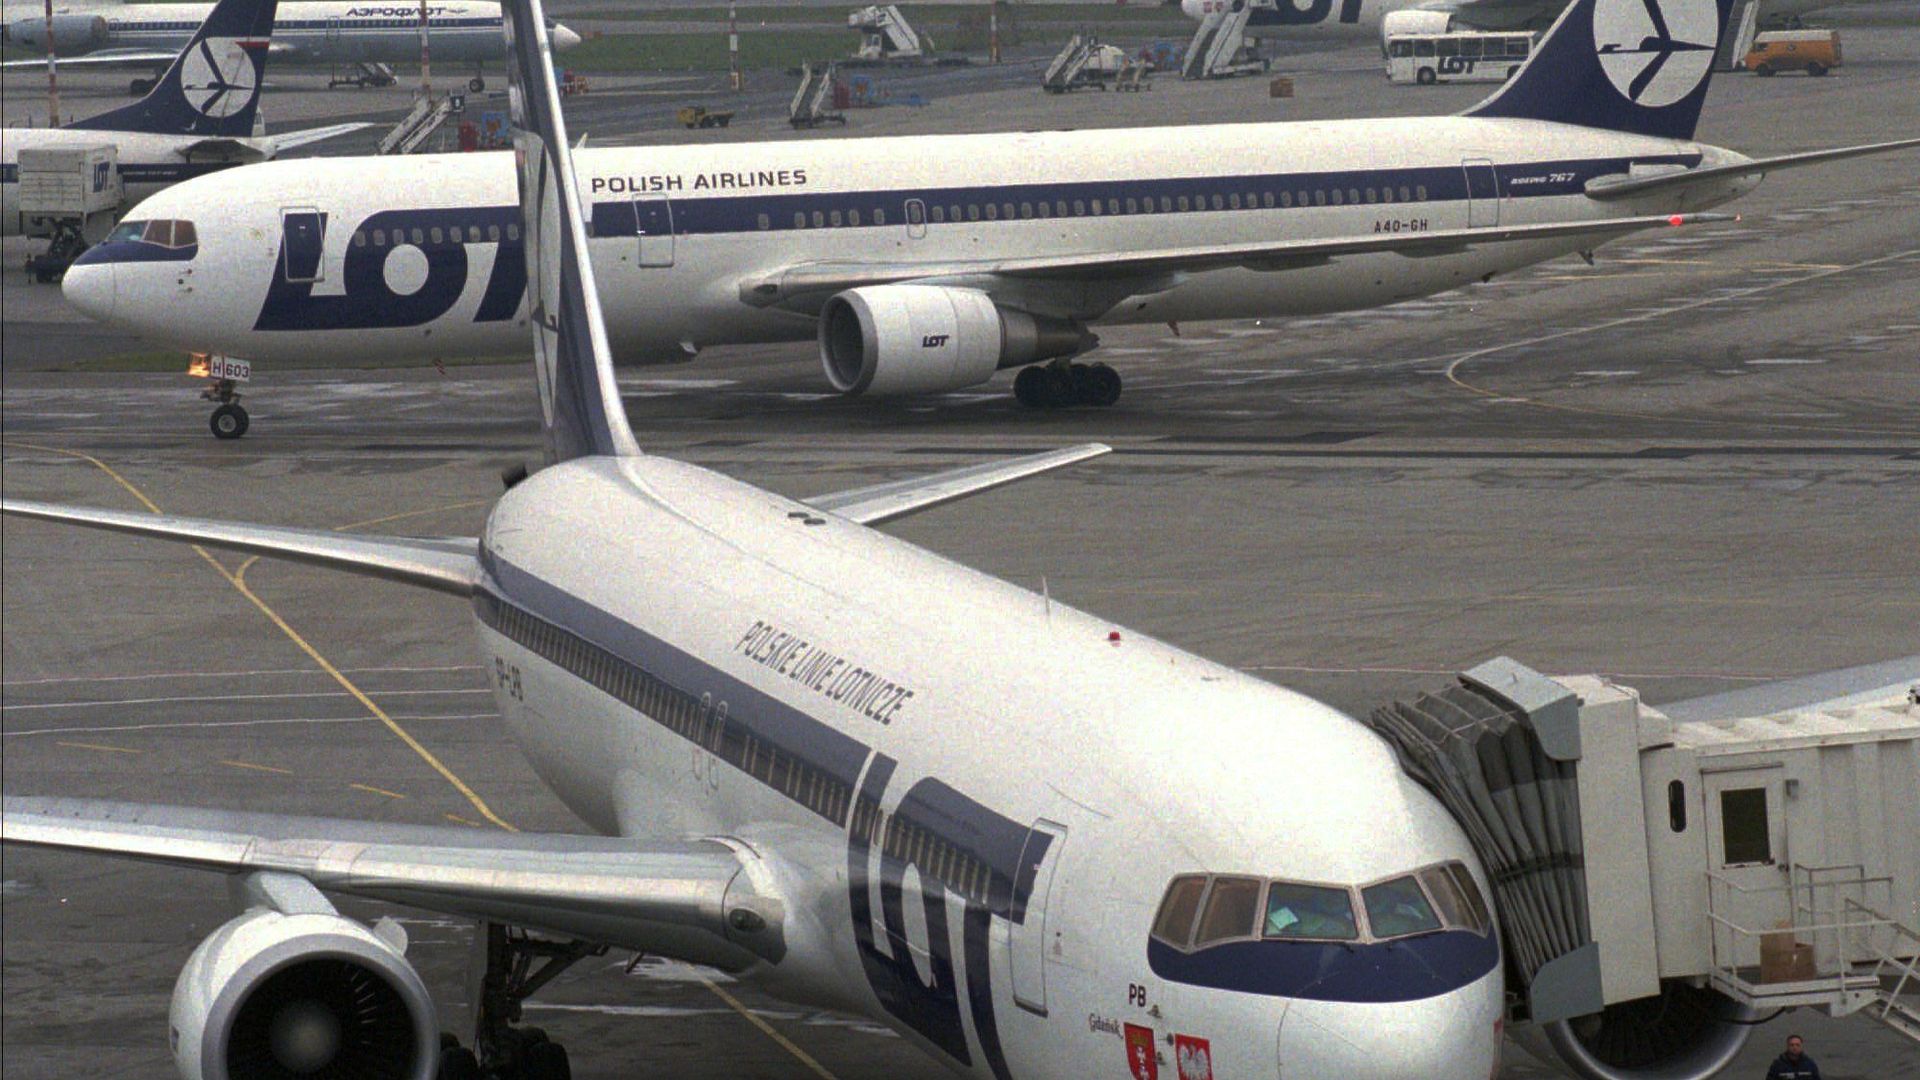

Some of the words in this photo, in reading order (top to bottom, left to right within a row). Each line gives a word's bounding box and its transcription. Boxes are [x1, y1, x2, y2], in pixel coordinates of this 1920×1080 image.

[1438, 56, 1475, 74] LOT
[591, 175, 683, 193] POLISH
[694, 169, 807, 189] AIRLINES
[1549, 172, 1576, 183] 767
[922, 335, 950, 347] LOT
[735, 620, 808, 674] POLSKIE
[789, 645, 845, 692] LINIE
[825, 663, 915, 725] LOTNICZE
[1128, 983, 1147, 1007] PB
